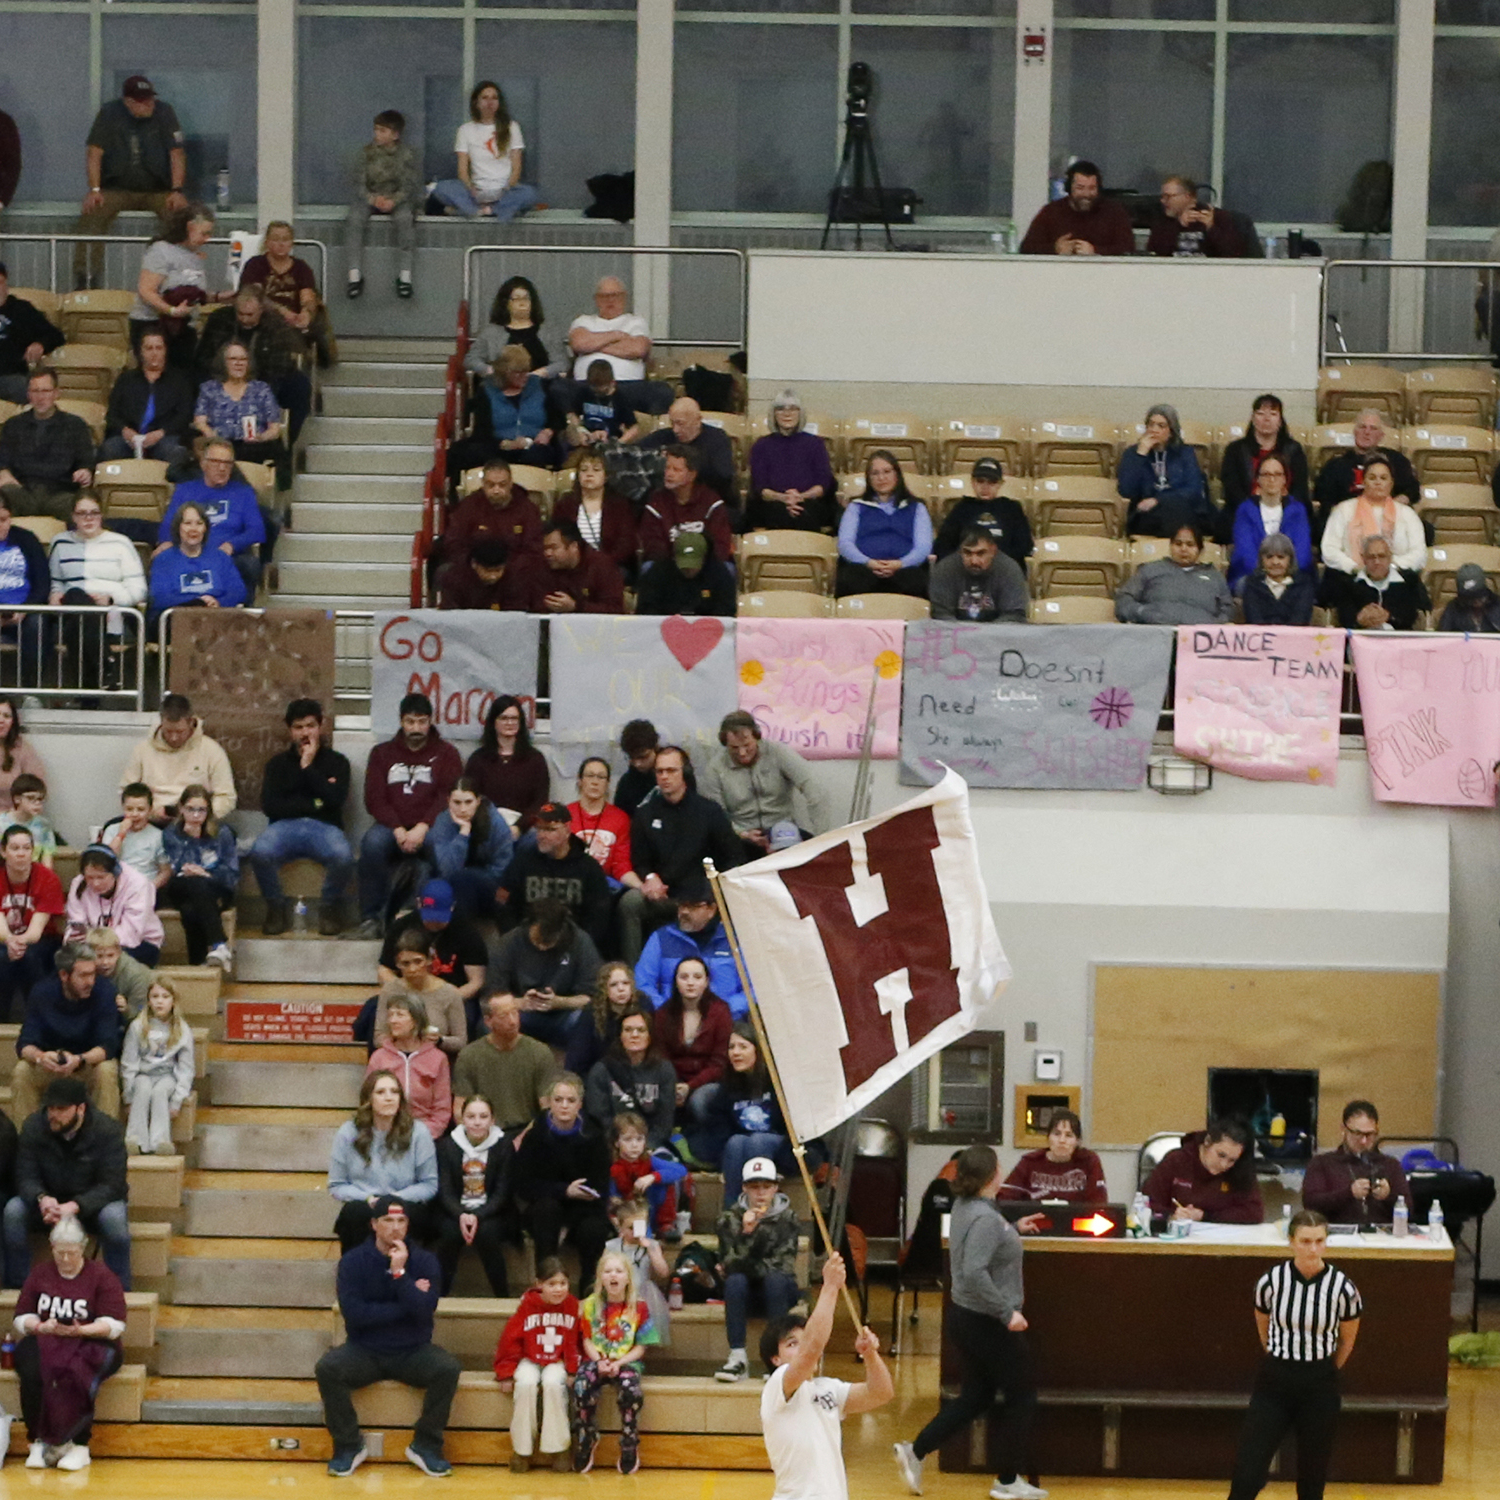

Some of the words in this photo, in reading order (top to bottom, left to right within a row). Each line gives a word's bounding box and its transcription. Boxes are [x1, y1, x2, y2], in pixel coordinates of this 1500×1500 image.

[379, 616, 443, 662] Go
[1194, 631, 1277, 655] DANCE
[907, 626, 981, 681] #5
[1267, 656, 1340, 680] TEAM
[526, 876, 582, 904] BEER
[778, 804, 962, 1095] H
[38, 1292, 90, 1319] PMS
